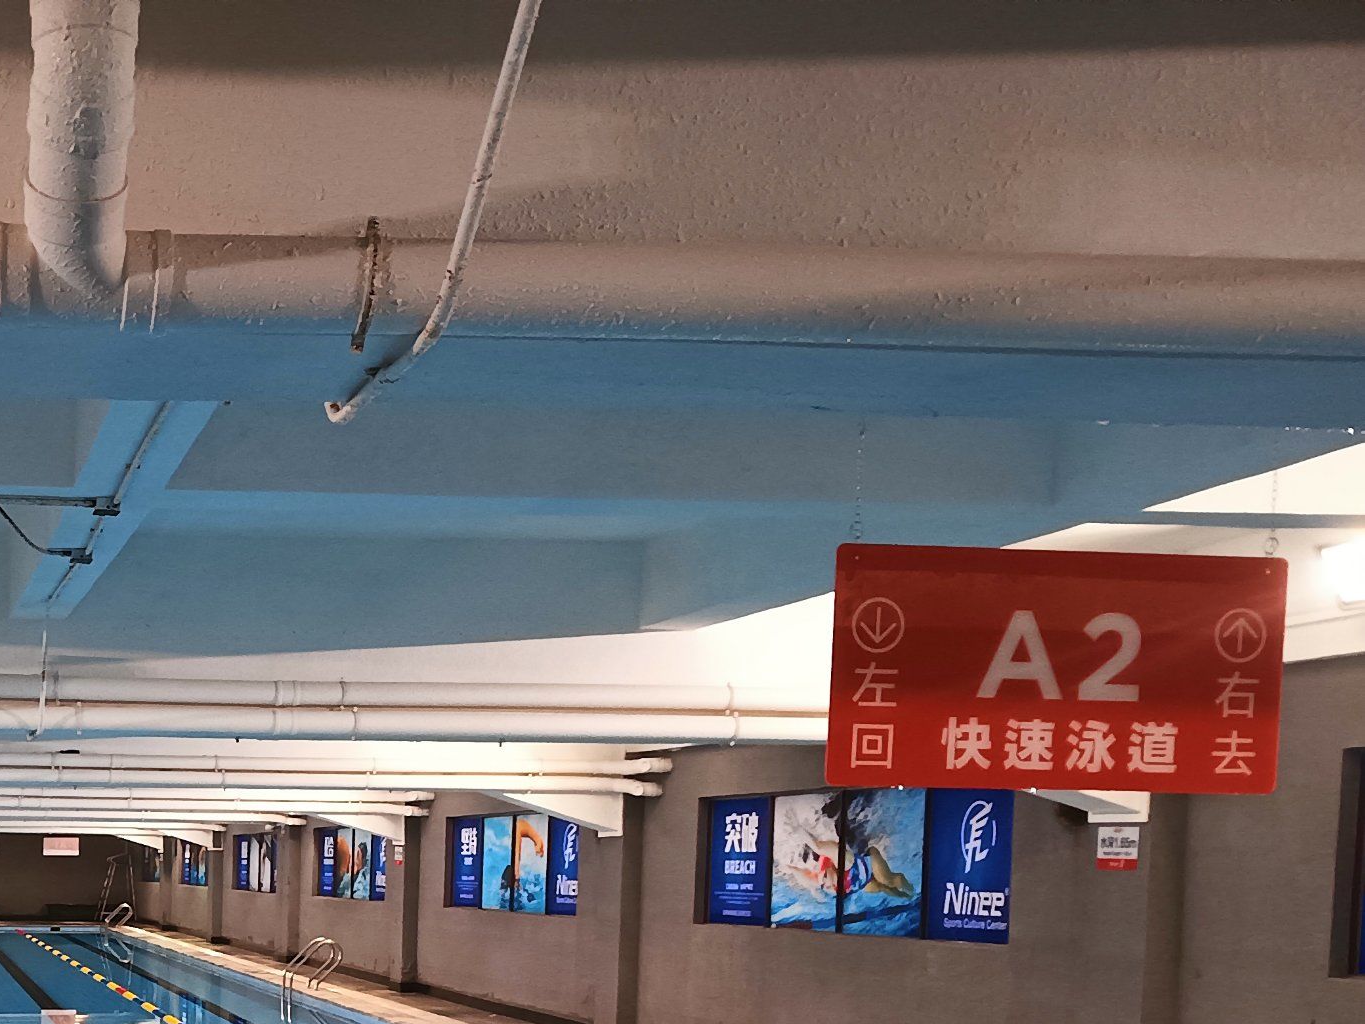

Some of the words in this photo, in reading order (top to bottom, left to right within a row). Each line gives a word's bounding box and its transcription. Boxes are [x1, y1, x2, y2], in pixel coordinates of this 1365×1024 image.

[976, 609, 1142, 702] A2
[850, 661, 898, 770] 左回
[940, 716, 1180, 774] 快速泳道
[1210, 671, 1261, 777] 右去
